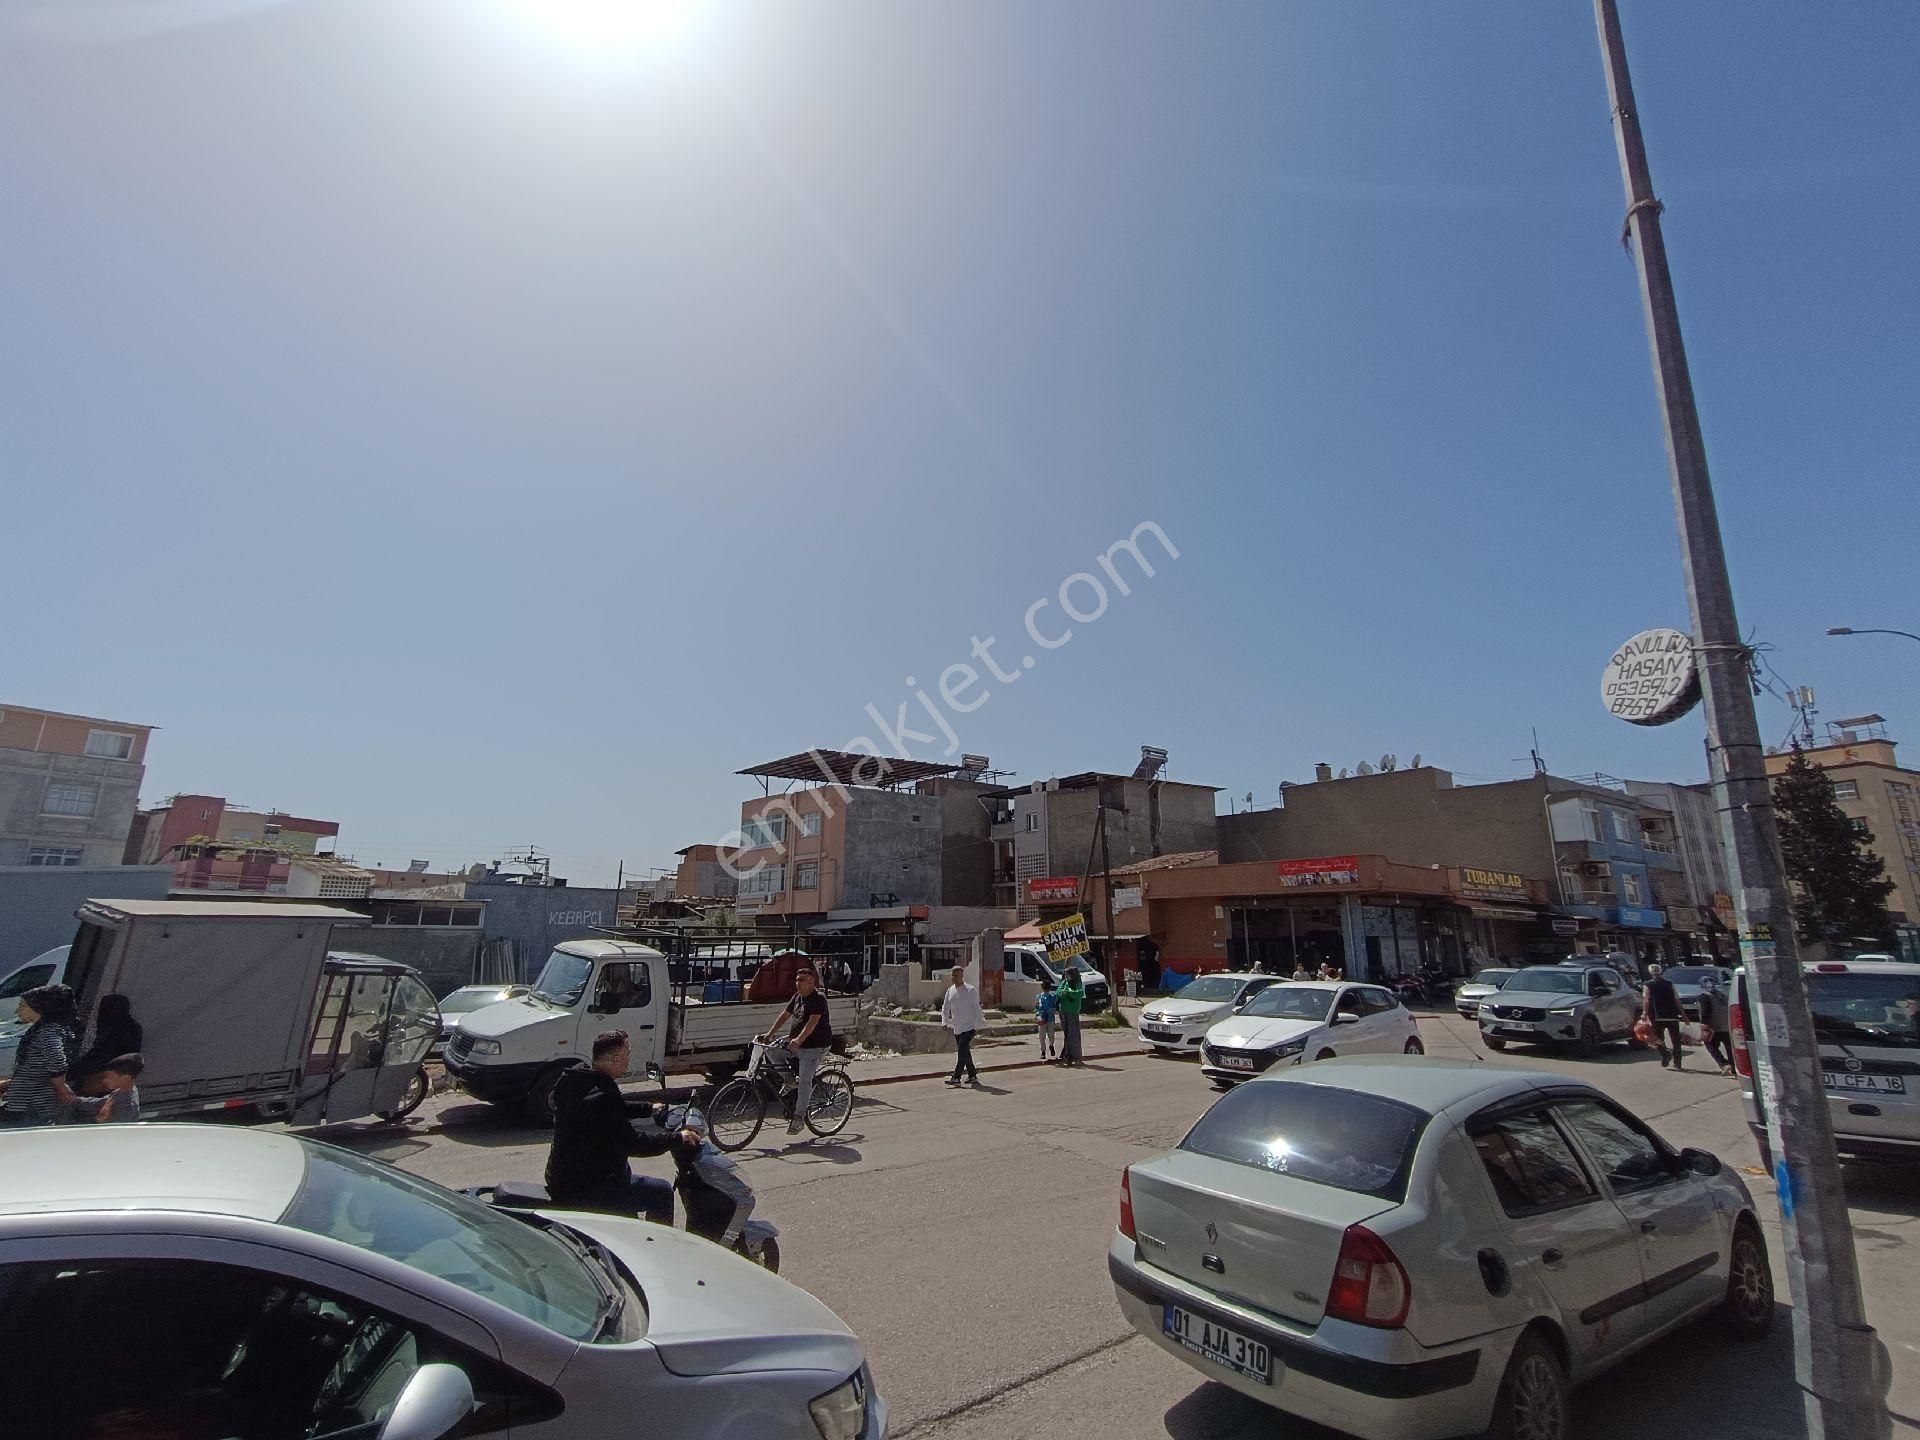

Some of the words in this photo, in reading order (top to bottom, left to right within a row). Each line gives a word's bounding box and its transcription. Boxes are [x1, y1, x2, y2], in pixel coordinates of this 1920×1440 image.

[1619, 656, 1684, 680] HASAN
[1463, 868, 1522, 887] TURANLAR
[1054, 937, 1078, 950] ARSA
[1823, 1074, 1837, 1085] 01
[1844, 1075, 1877, 1088] CFA
[1885, 1077, 1901, 1089] 16
[1174, 1308, 1190, 1337] 01
[1202, 1323, 1230, 1357] AJA
[1235, 1337, 1267, 1373] 310
